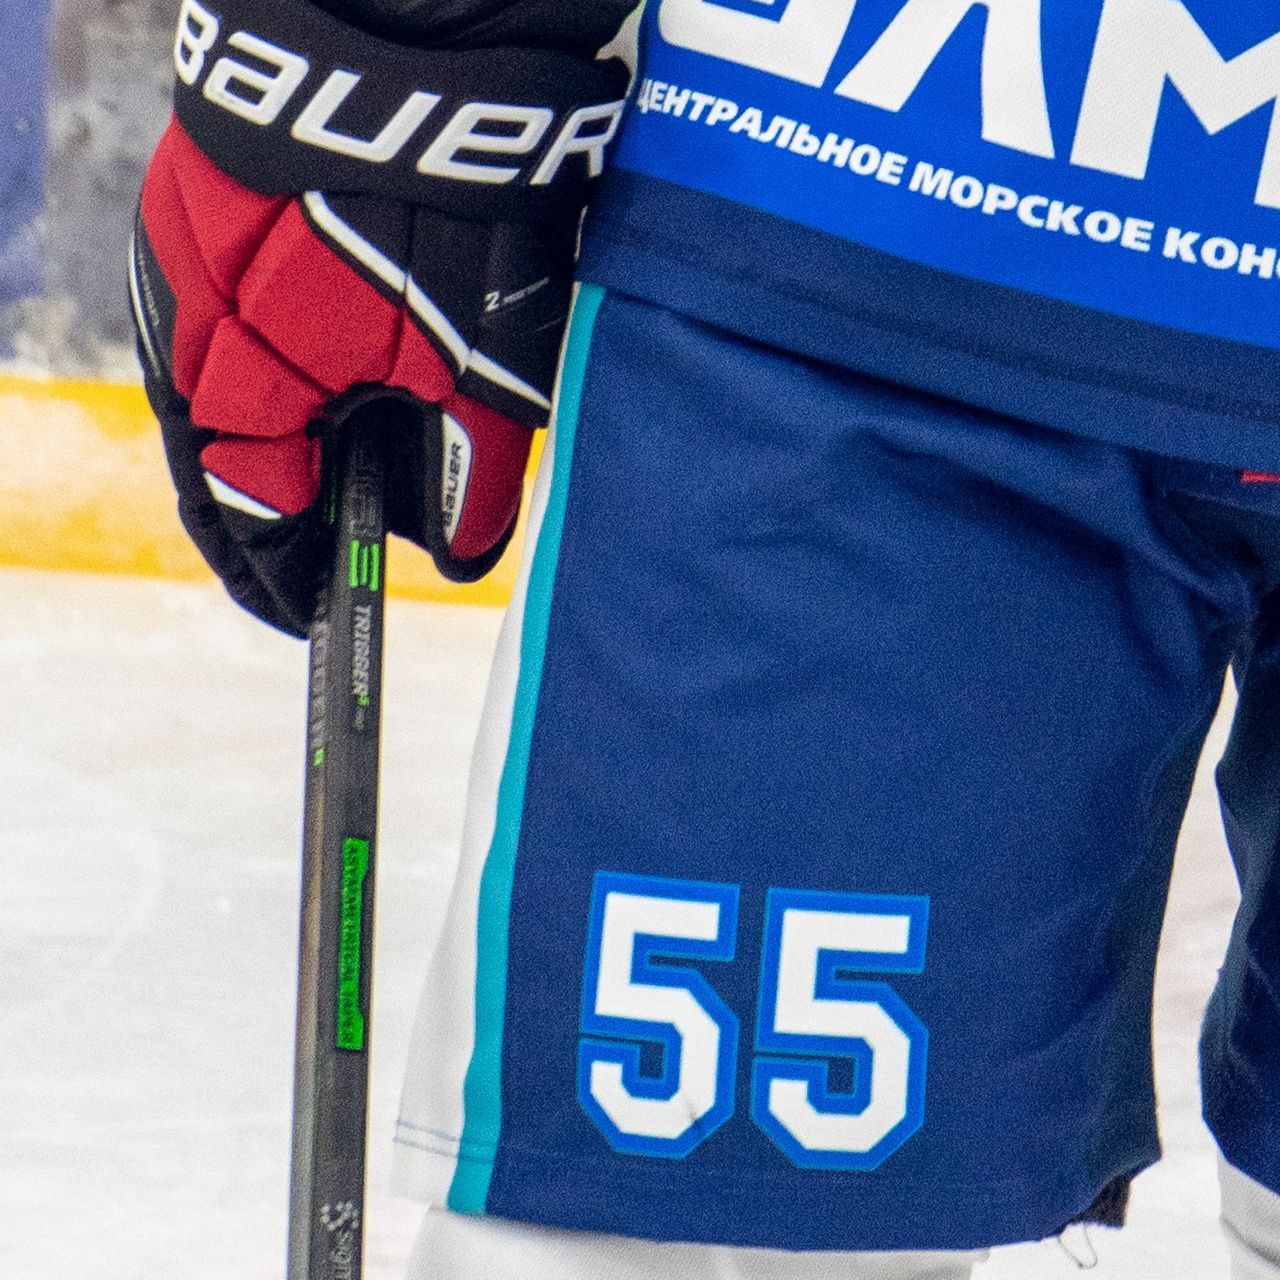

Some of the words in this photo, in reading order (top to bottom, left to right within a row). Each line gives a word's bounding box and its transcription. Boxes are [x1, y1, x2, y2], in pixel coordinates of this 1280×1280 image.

[635, 77, 909, 187] ЦЕНТРАЛЬНОЕ
[909, 161, 1154, 253] МОРСКОЕ
[589, 890, 912, 1155] 55
